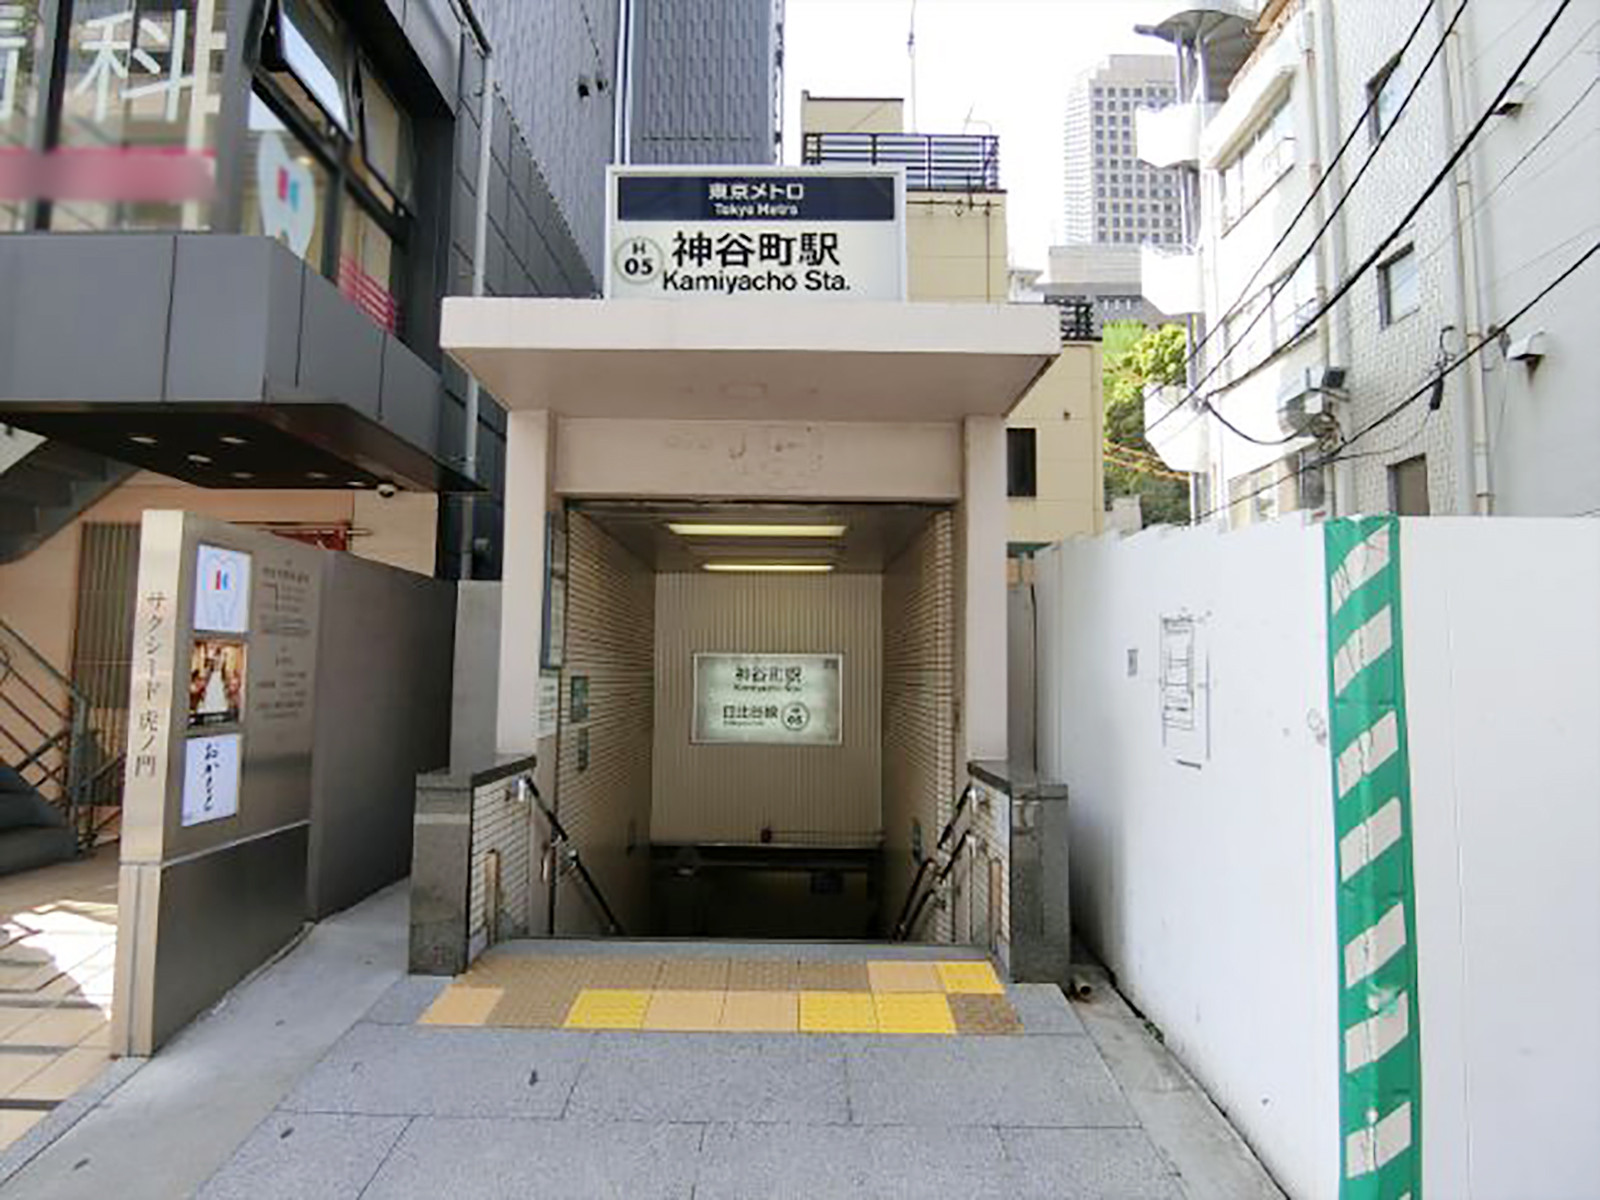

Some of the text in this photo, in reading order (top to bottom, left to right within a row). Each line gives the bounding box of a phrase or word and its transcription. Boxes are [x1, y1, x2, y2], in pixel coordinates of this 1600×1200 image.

[709, 183, 804, 200] 東京メトロ
[714, 203, 798, 217] Tokyo Metro
[632, 242, 647, 255] H
[672, 230, 840, 267] 神谷町駅
[624, 258, 653, 276] 05
[804, 269, 851, 291] Sta.
